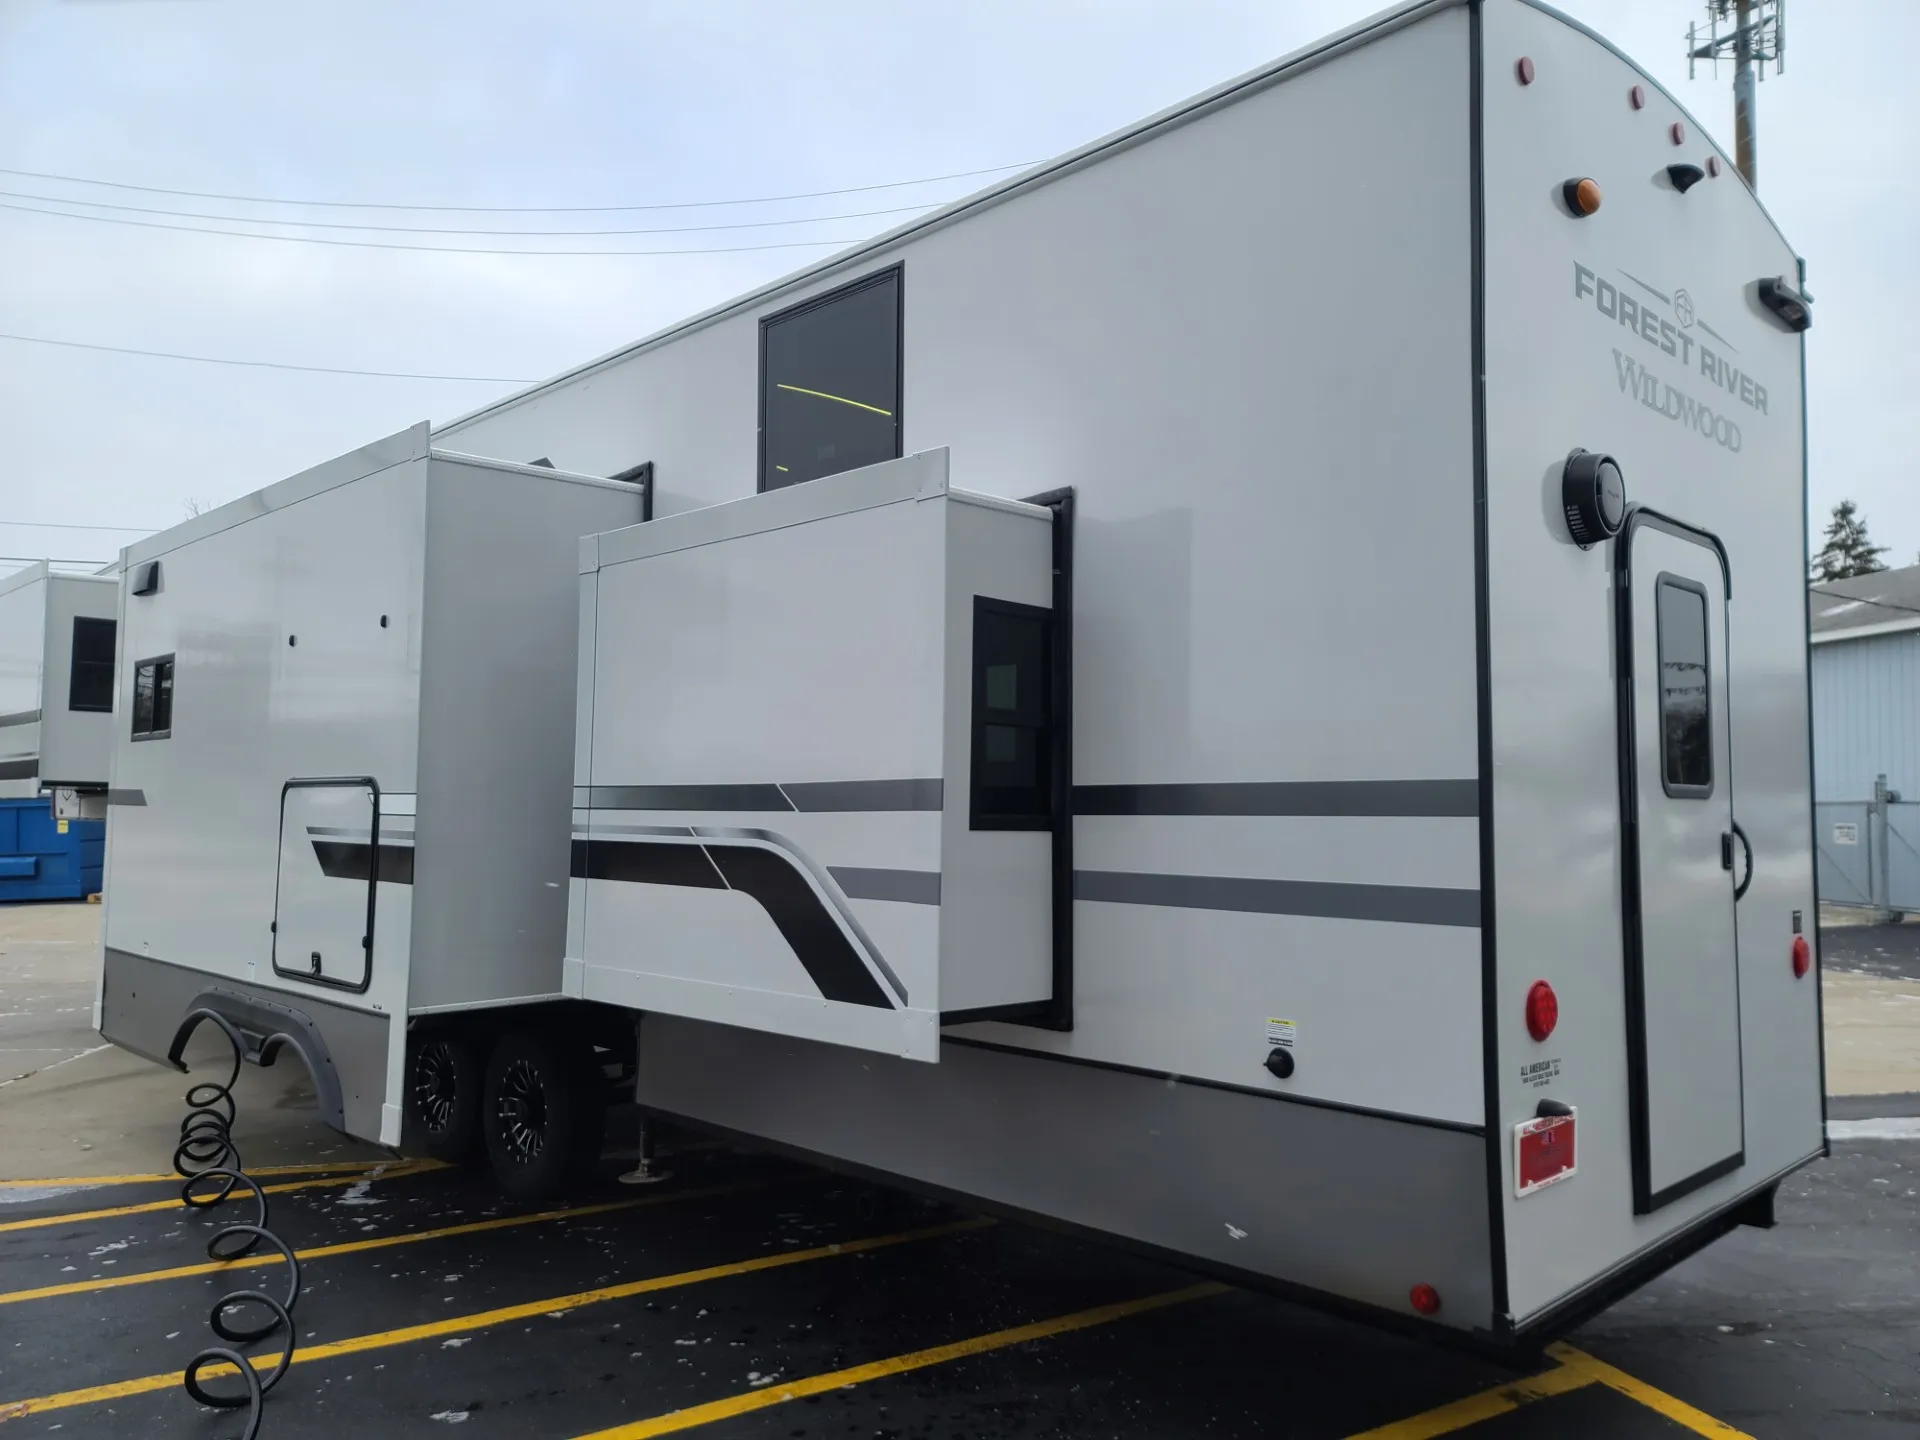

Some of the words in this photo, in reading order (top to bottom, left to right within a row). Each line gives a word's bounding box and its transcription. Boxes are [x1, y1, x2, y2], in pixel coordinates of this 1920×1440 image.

[1573, 260, 1694, 366] FOREST
[1700, 343, 1768, 416] RIVER
[1611, 347, 1741, 453] WILDWOOD
[1520, 1065, 1528, 1077] ALL
[1529, 1059, 1551, 1075] AMERICAN
